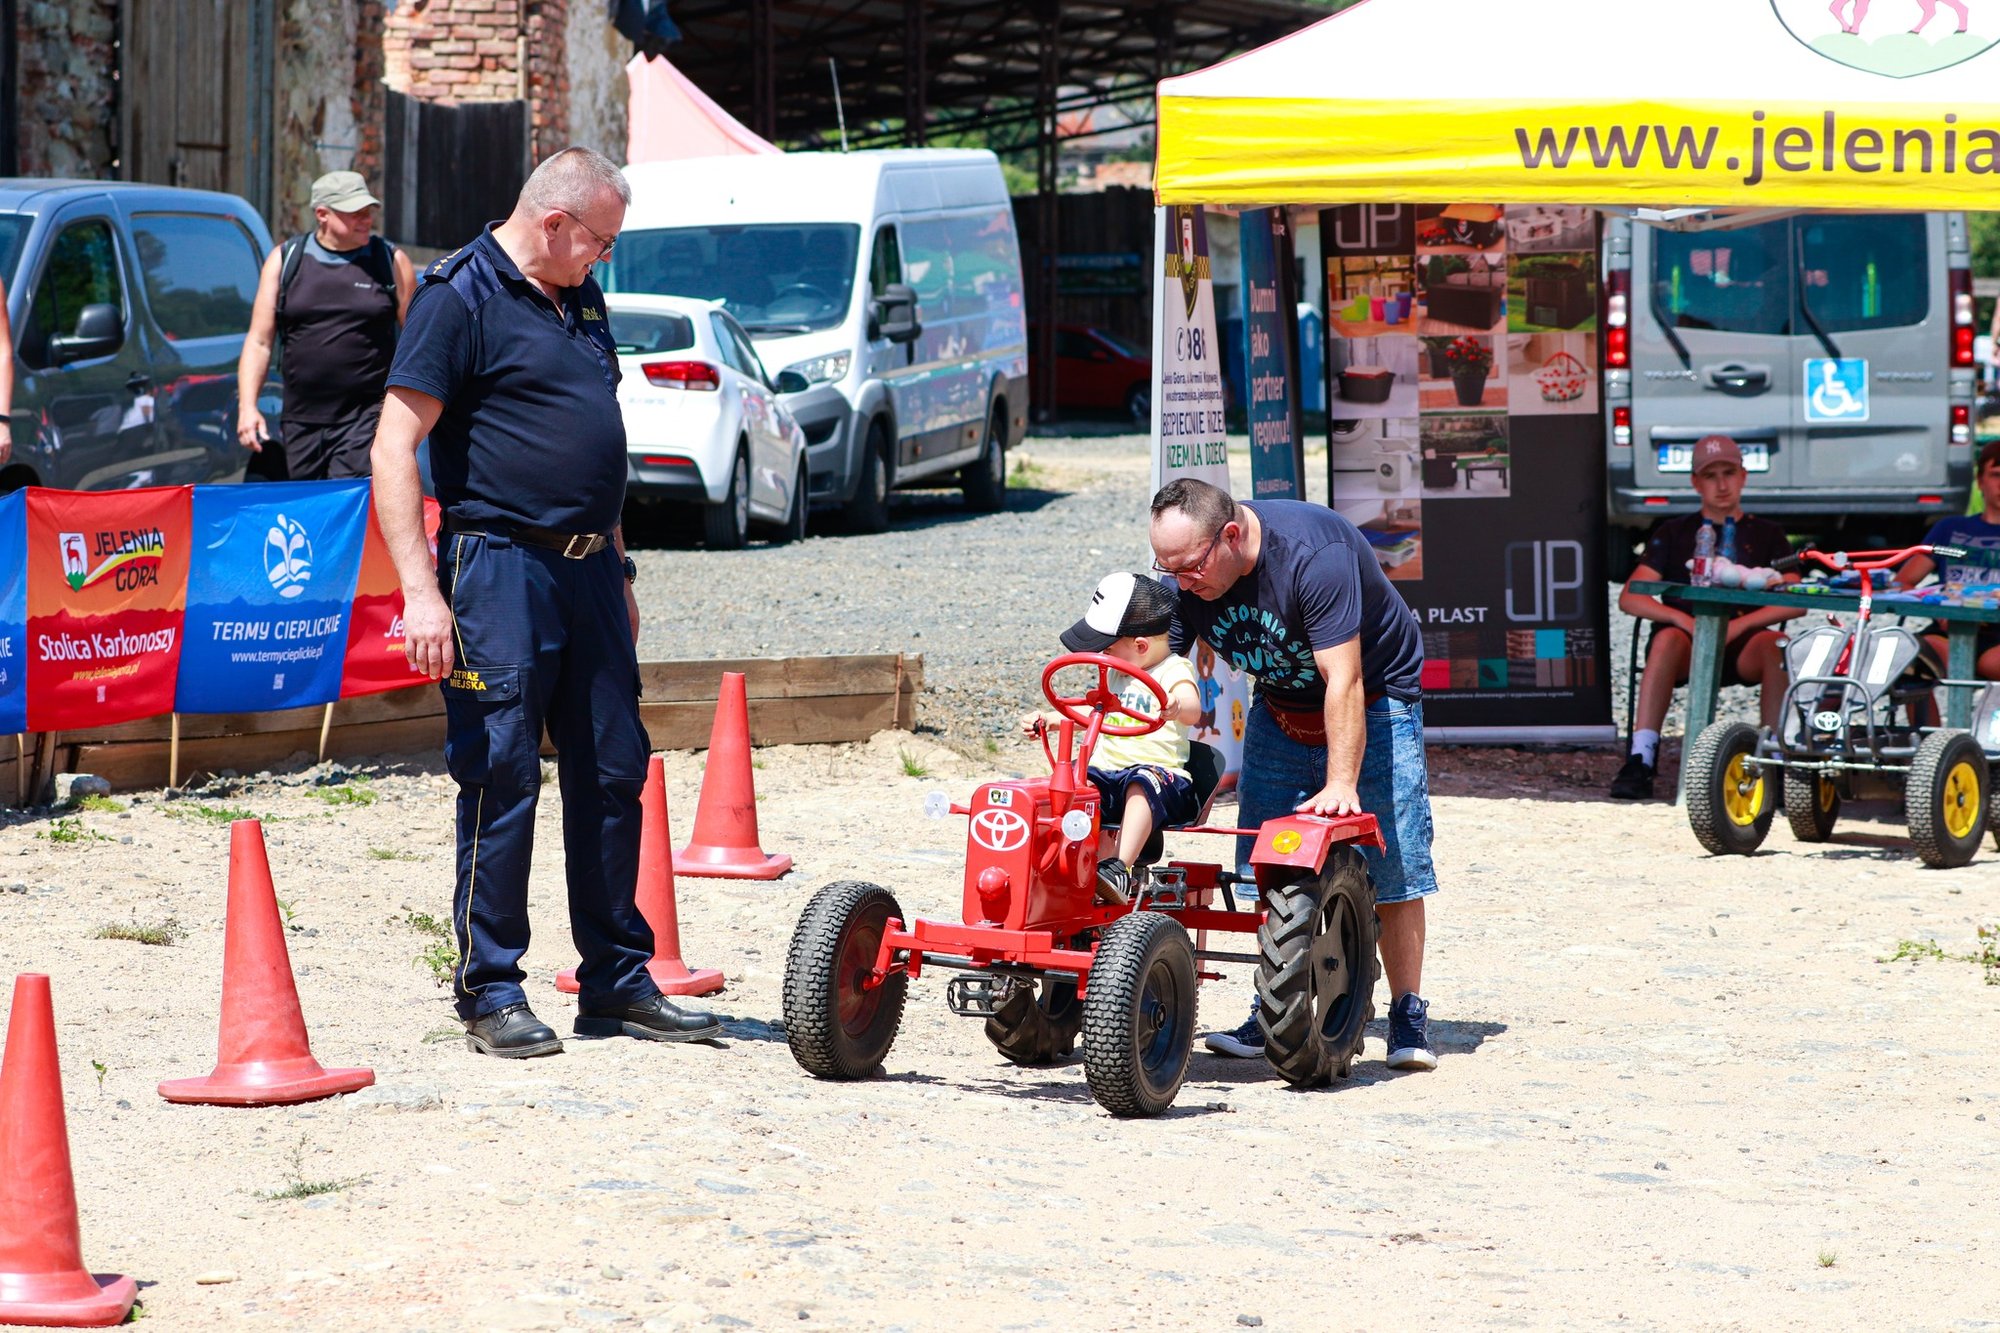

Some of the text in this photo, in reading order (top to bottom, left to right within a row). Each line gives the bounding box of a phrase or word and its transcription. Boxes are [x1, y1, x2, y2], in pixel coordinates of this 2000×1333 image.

[1252, 370, 1285, 409] partner
[1254, 411, 1291, 453] regionu!
[94, 527, 164, 556] JELENIA
[115, 558, 159, 592] GÓRA
[212, 614, 342, 641] TERMY CIEPLICKIE
[1208, 603, 1287, 649] CALIFORNIA
[1428, 606, 1489, 624] PLAST
[38, 627, 177, 662] Stolica Karkonoszy
[231, 644, 324, 665] www.termycieplickie.pl
[449, 678, 487, 690] MIEJSKA
